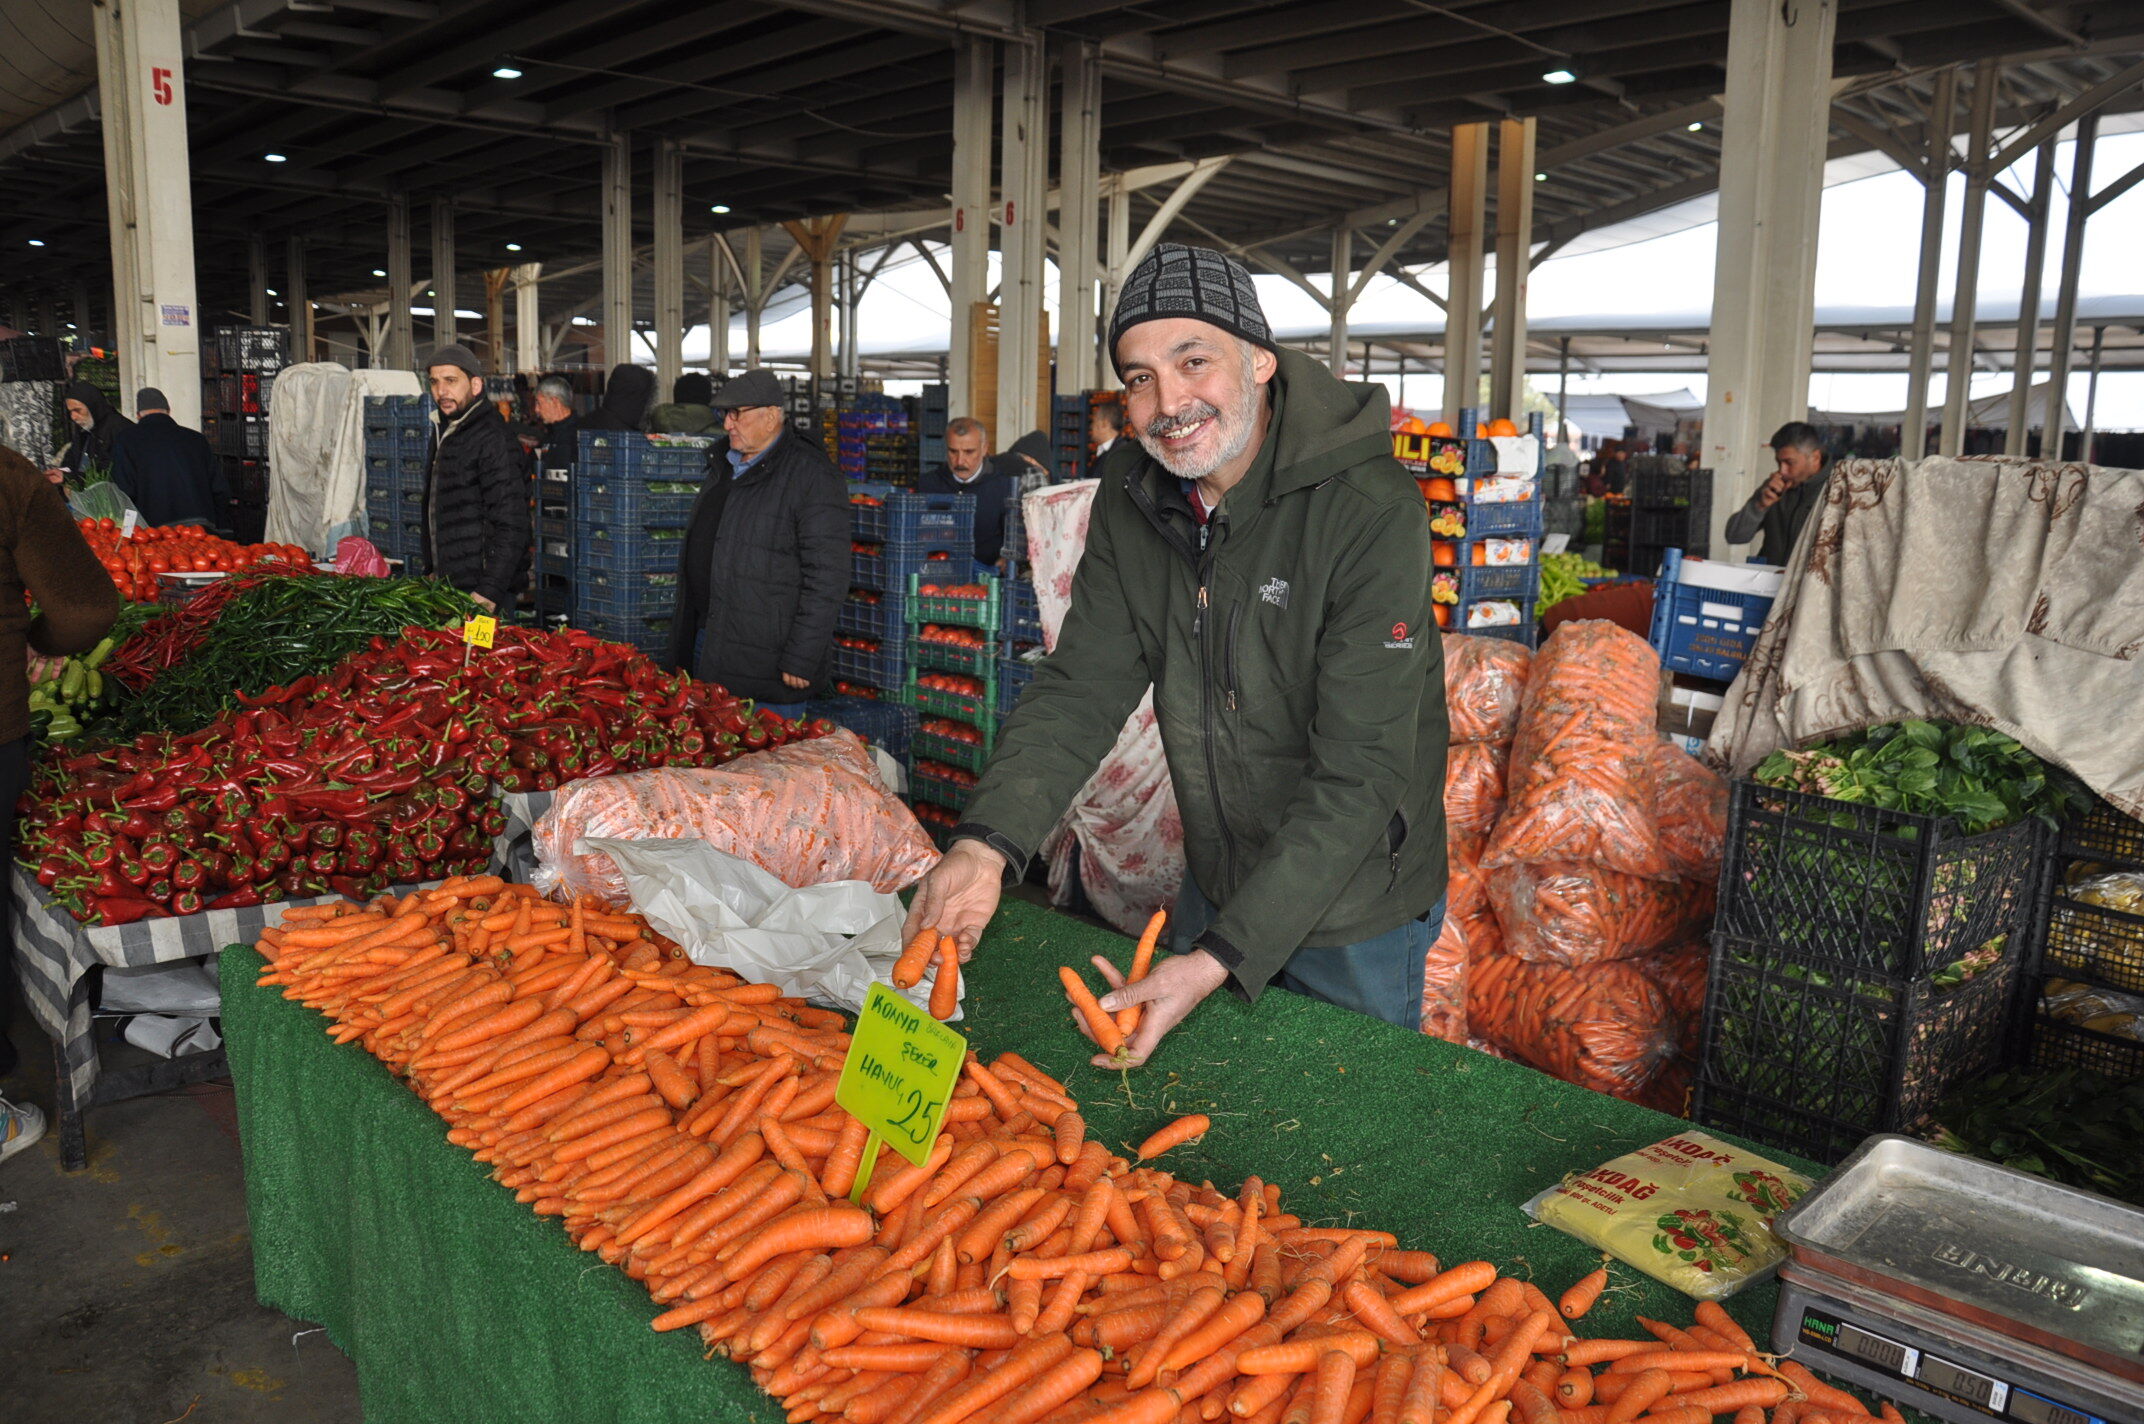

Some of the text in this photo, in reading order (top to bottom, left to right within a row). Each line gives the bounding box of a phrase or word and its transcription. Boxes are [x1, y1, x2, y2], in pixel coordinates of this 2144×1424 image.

[152, 67, 173, 106] 5
[956, 207, 964, 232] 6
[1006, 200, 1015, 226] 6
[871, 994, 920, 1034] KONYA
[886, 1089, 943, 1144] 25
[1804, 1316, 1835, 1334] HANA
